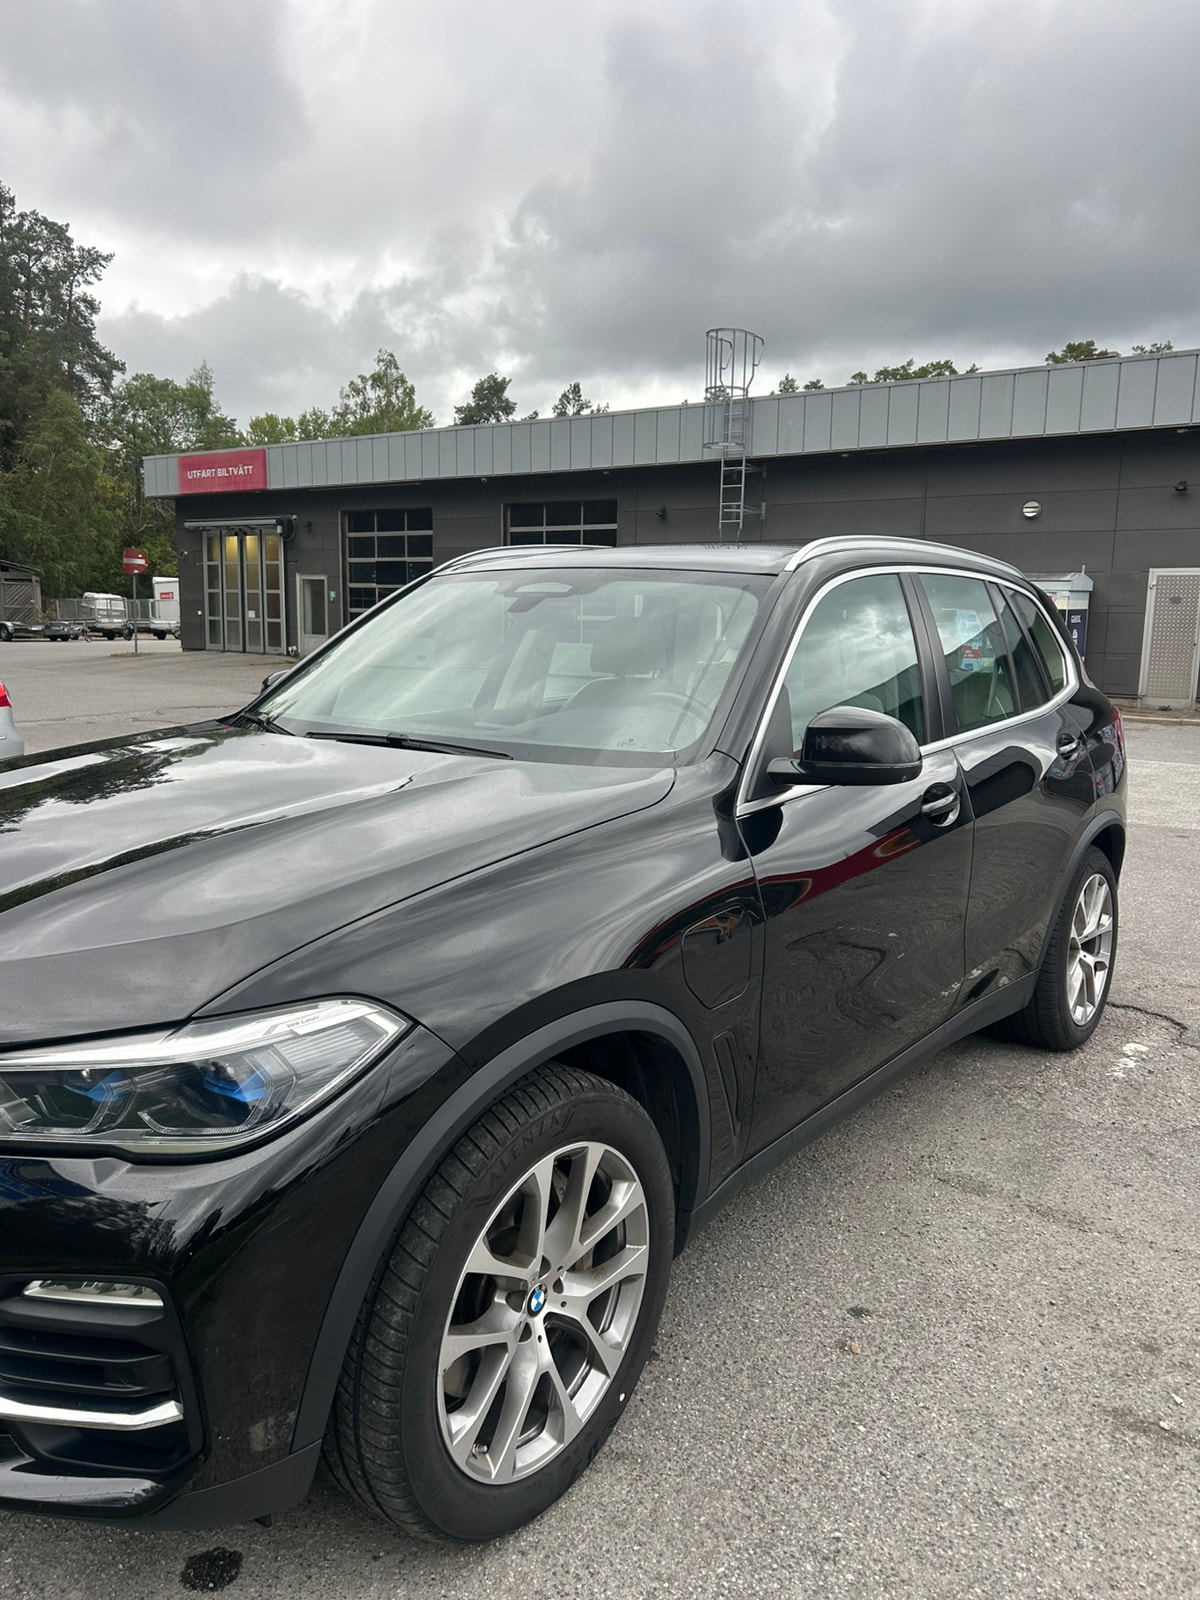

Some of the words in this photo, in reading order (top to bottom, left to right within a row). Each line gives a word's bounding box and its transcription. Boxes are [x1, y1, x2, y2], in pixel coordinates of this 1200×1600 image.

[187, 469, 216, 479] UTFART
[217, 464, 253, 477] BILTVÄTT
[489, 1112, 561, 1188] ALENZA
